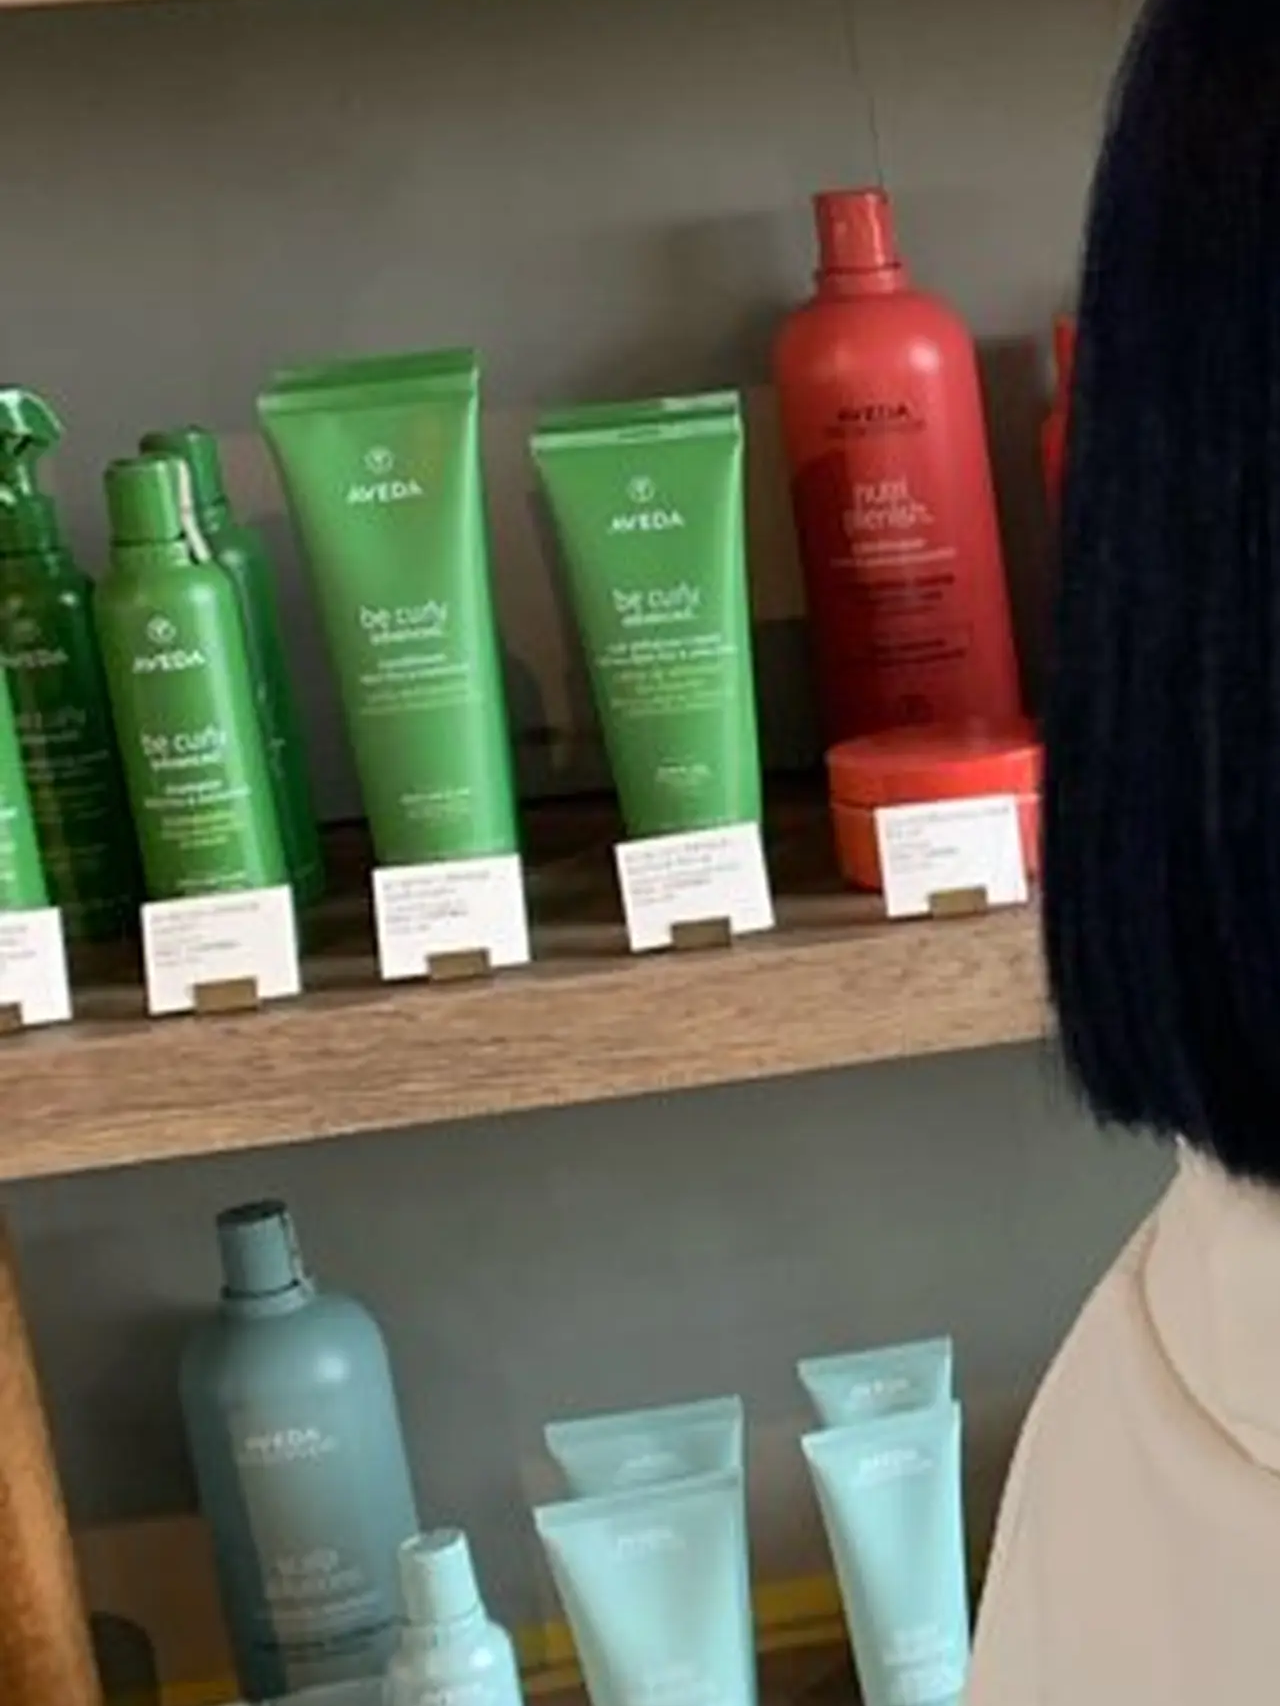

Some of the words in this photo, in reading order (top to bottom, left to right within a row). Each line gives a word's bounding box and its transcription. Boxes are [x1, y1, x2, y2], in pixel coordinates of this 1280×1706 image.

[346, 479, 425, 504] AVEDA
[609, 509, 685, 533] AVEDA
[132, 650, 206, 674] AVEDA
